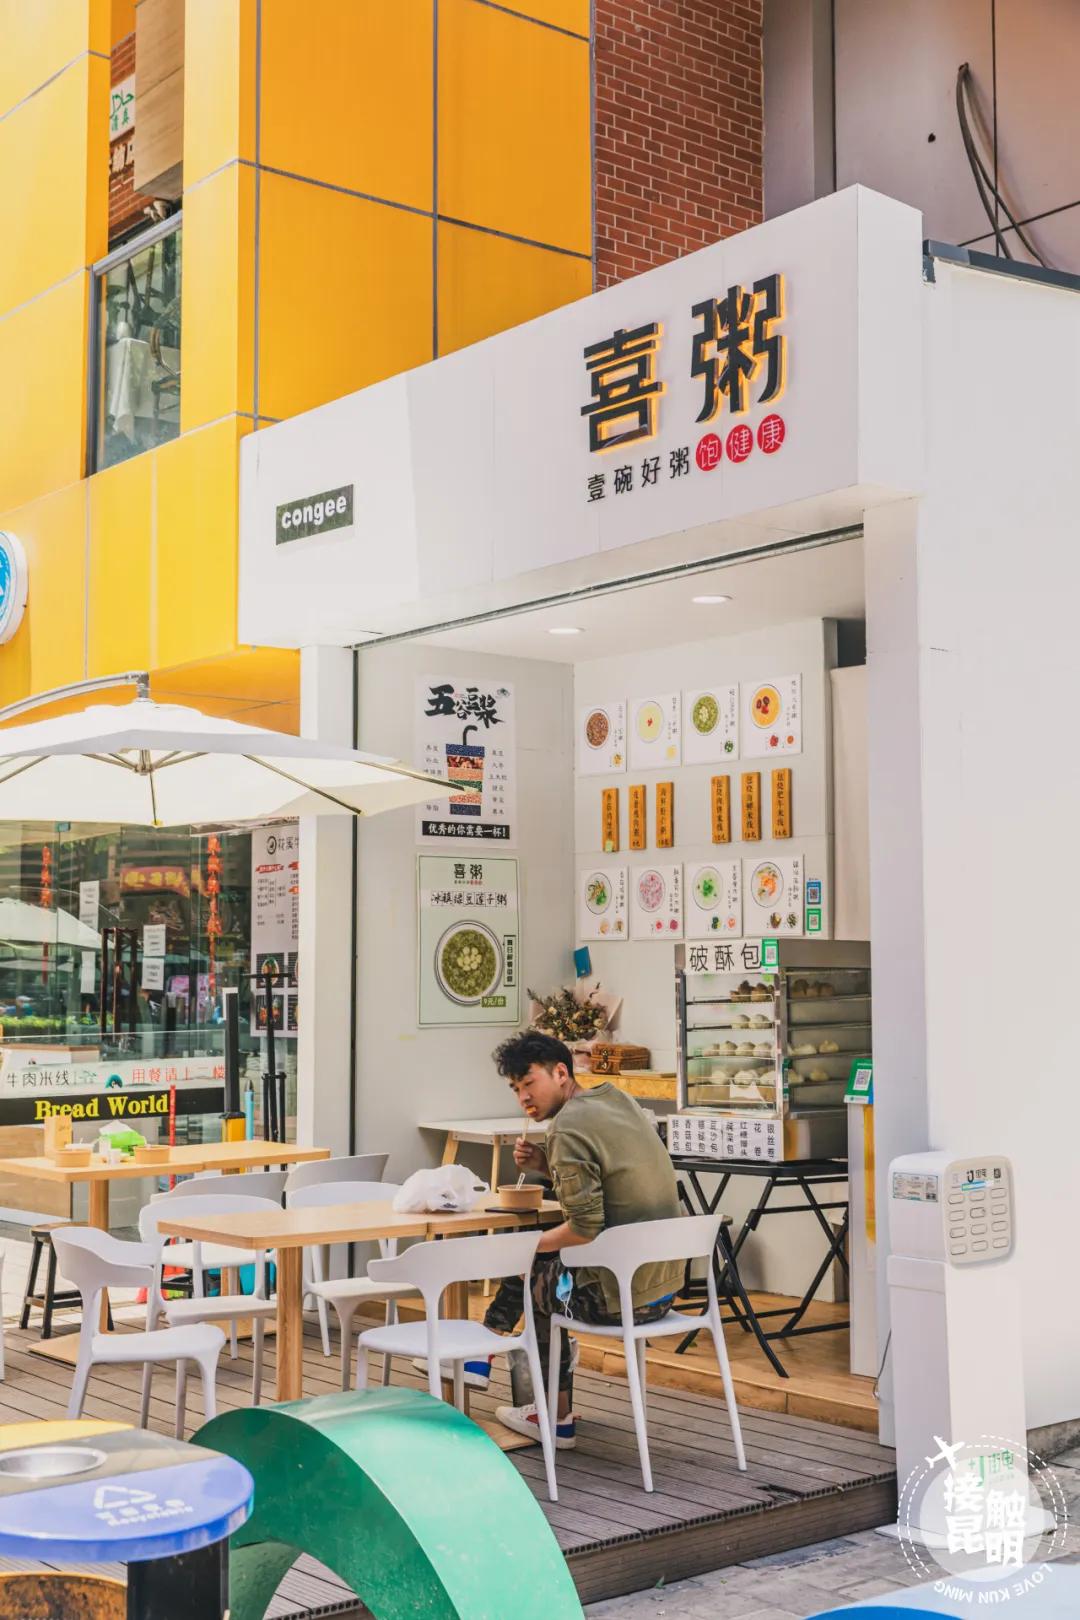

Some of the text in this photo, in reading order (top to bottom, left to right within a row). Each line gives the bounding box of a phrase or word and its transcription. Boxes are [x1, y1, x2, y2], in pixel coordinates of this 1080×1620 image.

[580, 272, 785, 454] 喜粥
[586, 415, 785, 503] 壹碗好粥 饱健康
[281, 495, 347, 529] congee
[424, 683, 505, 729] 五谷豆浆
[453, 863, 483, 880] 喜粥
[689, 943, 762, 972] 破酥包
[7, 1069, 71, 1088] 牛肉米线
[34, 1093, 169, 1121] Bread World
